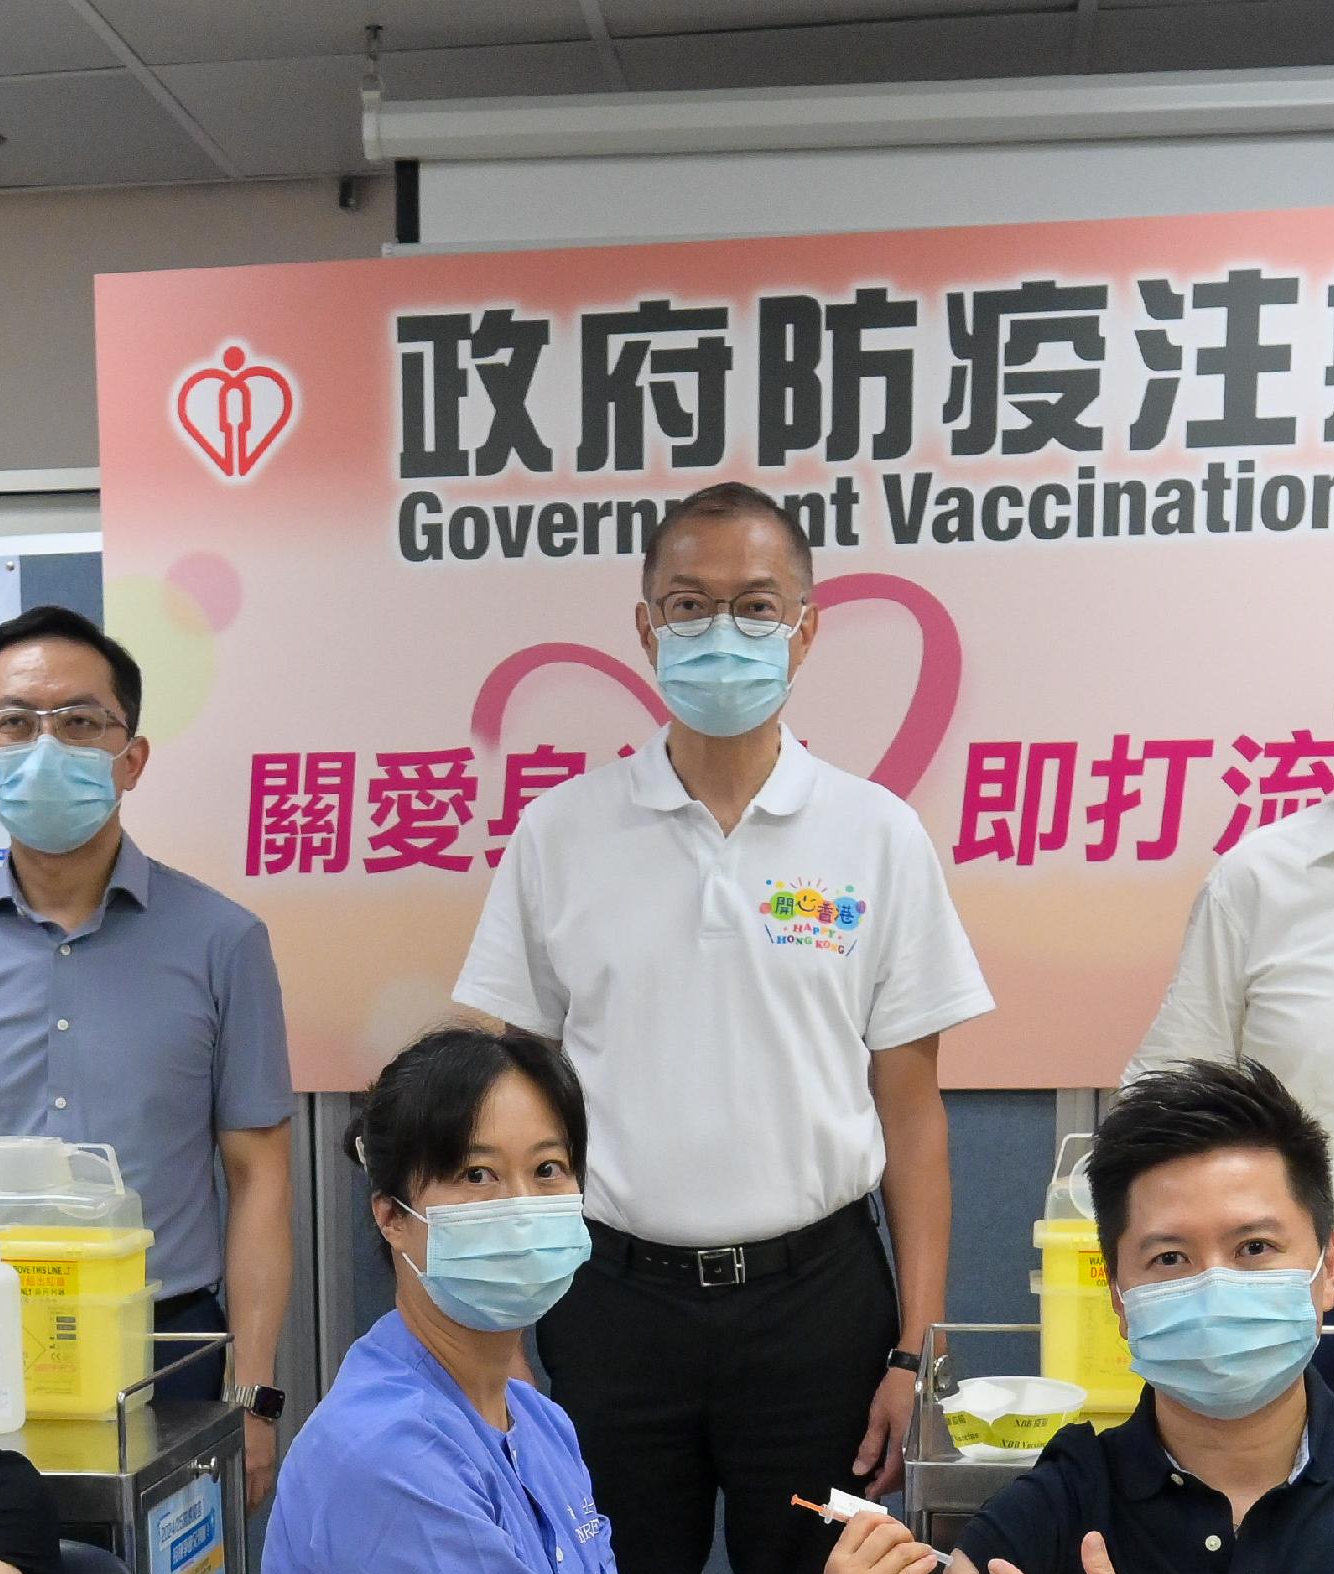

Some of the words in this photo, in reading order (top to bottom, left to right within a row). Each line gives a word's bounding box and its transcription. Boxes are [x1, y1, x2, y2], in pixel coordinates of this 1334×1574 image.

[399, 477, 860, 563] Governnt
[792, 923, 835, 938] HAPPY
[776, 935, 813, 945] HONG
[815, 939, 845, 955] KONG
